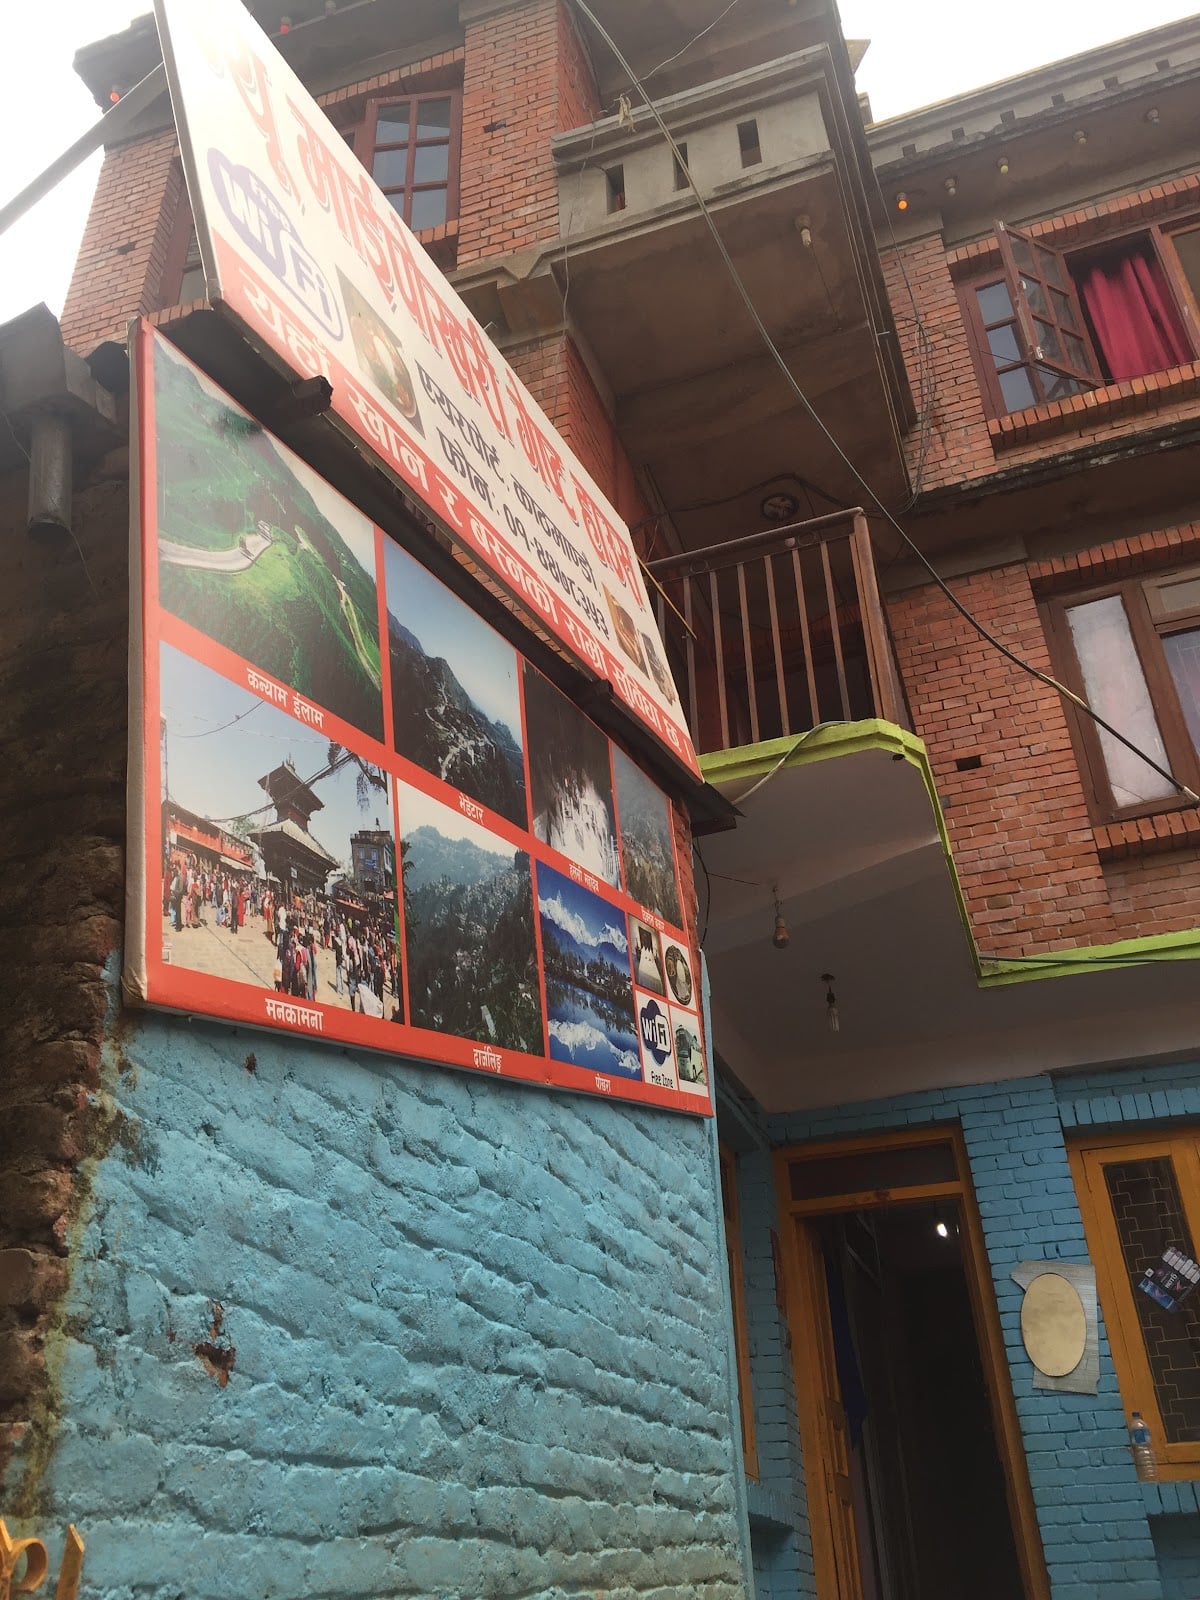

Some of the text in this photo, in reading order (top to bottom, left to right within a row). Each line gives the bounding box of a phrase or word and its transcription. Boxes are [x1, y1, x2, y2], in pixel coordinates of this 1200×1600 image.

[248, 174, 291, 234] Free
[286, 95, 514, 448] माईपोखरी
[506, 368, 579, 527] गेष्ट
[570, 471, 647, 612] हाउस
[343, 375, 428, 491] खान
[437, 478, 463, 527] र
[467, 508, 559, 624] बस्नको
[561, 607, 607, 676] राम्रो
[610, 659, 662, 733] सुविधा
[664, 716, 682, 753] छ
[503, 503, 610, 641] ०१-४४७८३५३
[246, 667, 324, 729] कन्याम ईलाम
[265, 996, 325, 1033] मनकामना
[650, 1070, 662, 1085] Free
